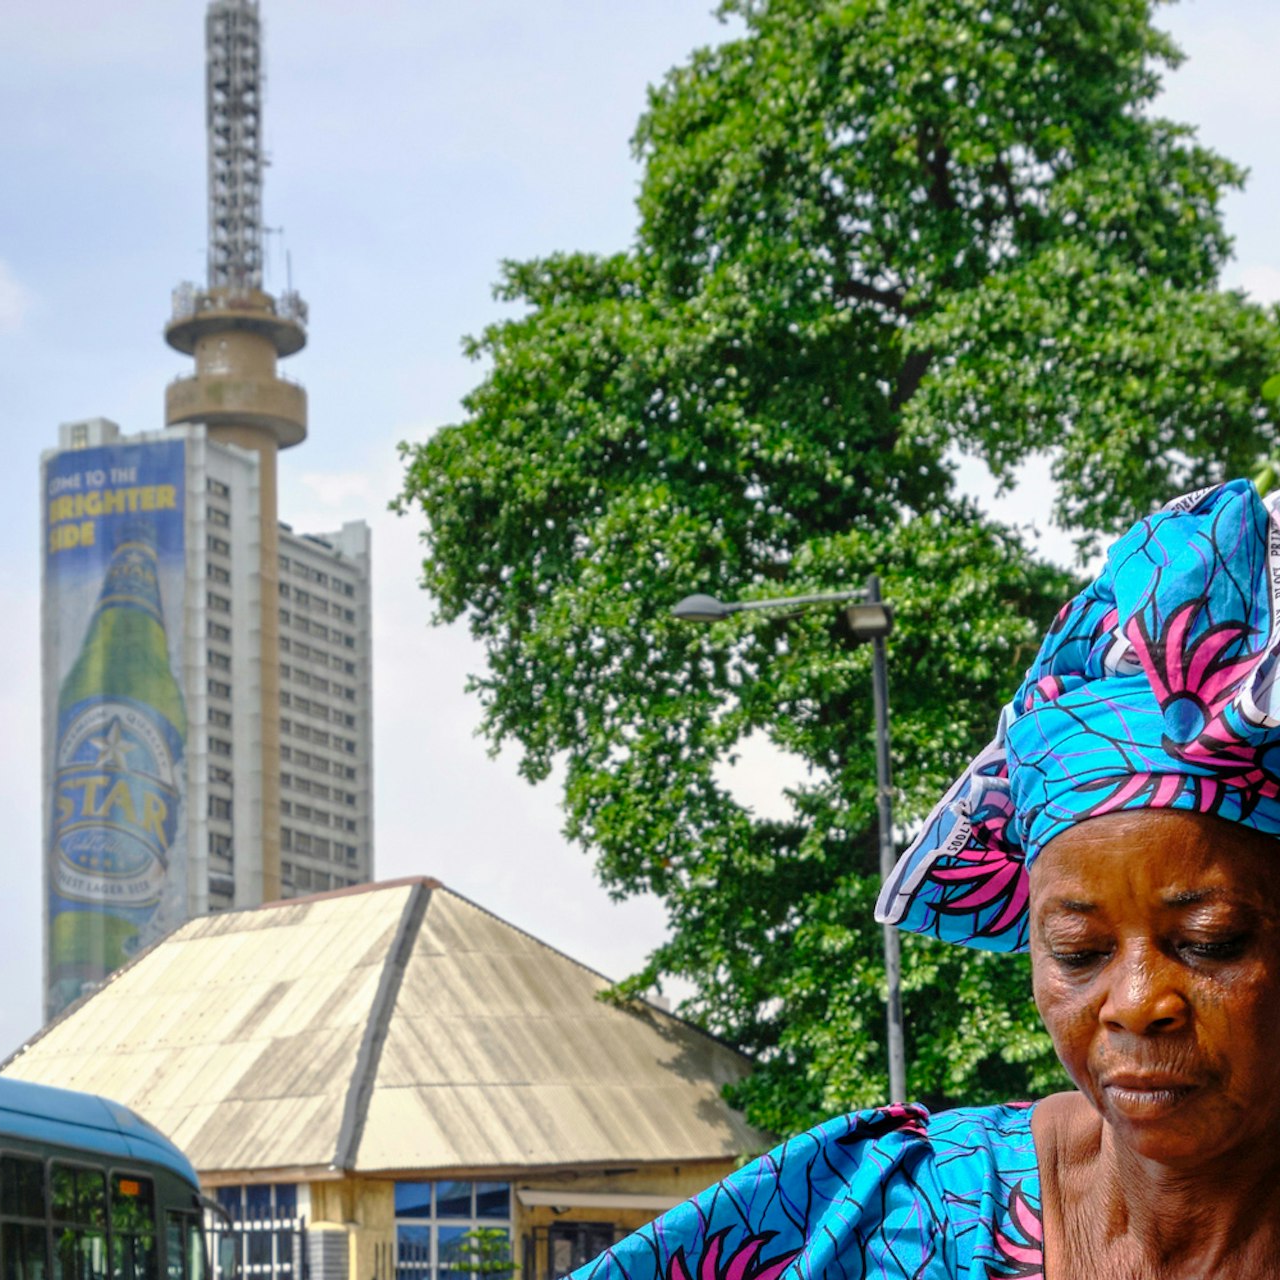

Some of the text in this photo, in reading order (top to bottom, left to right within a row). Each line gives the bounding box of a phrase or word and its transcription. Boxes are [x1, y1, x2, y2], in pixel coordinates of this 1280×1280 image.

[85, 469, 105, 486] TO
[110, 467, 137, 483] THE
[55, 776, 170, 853] STAR
[86, 878, 124, 895] LAGER
